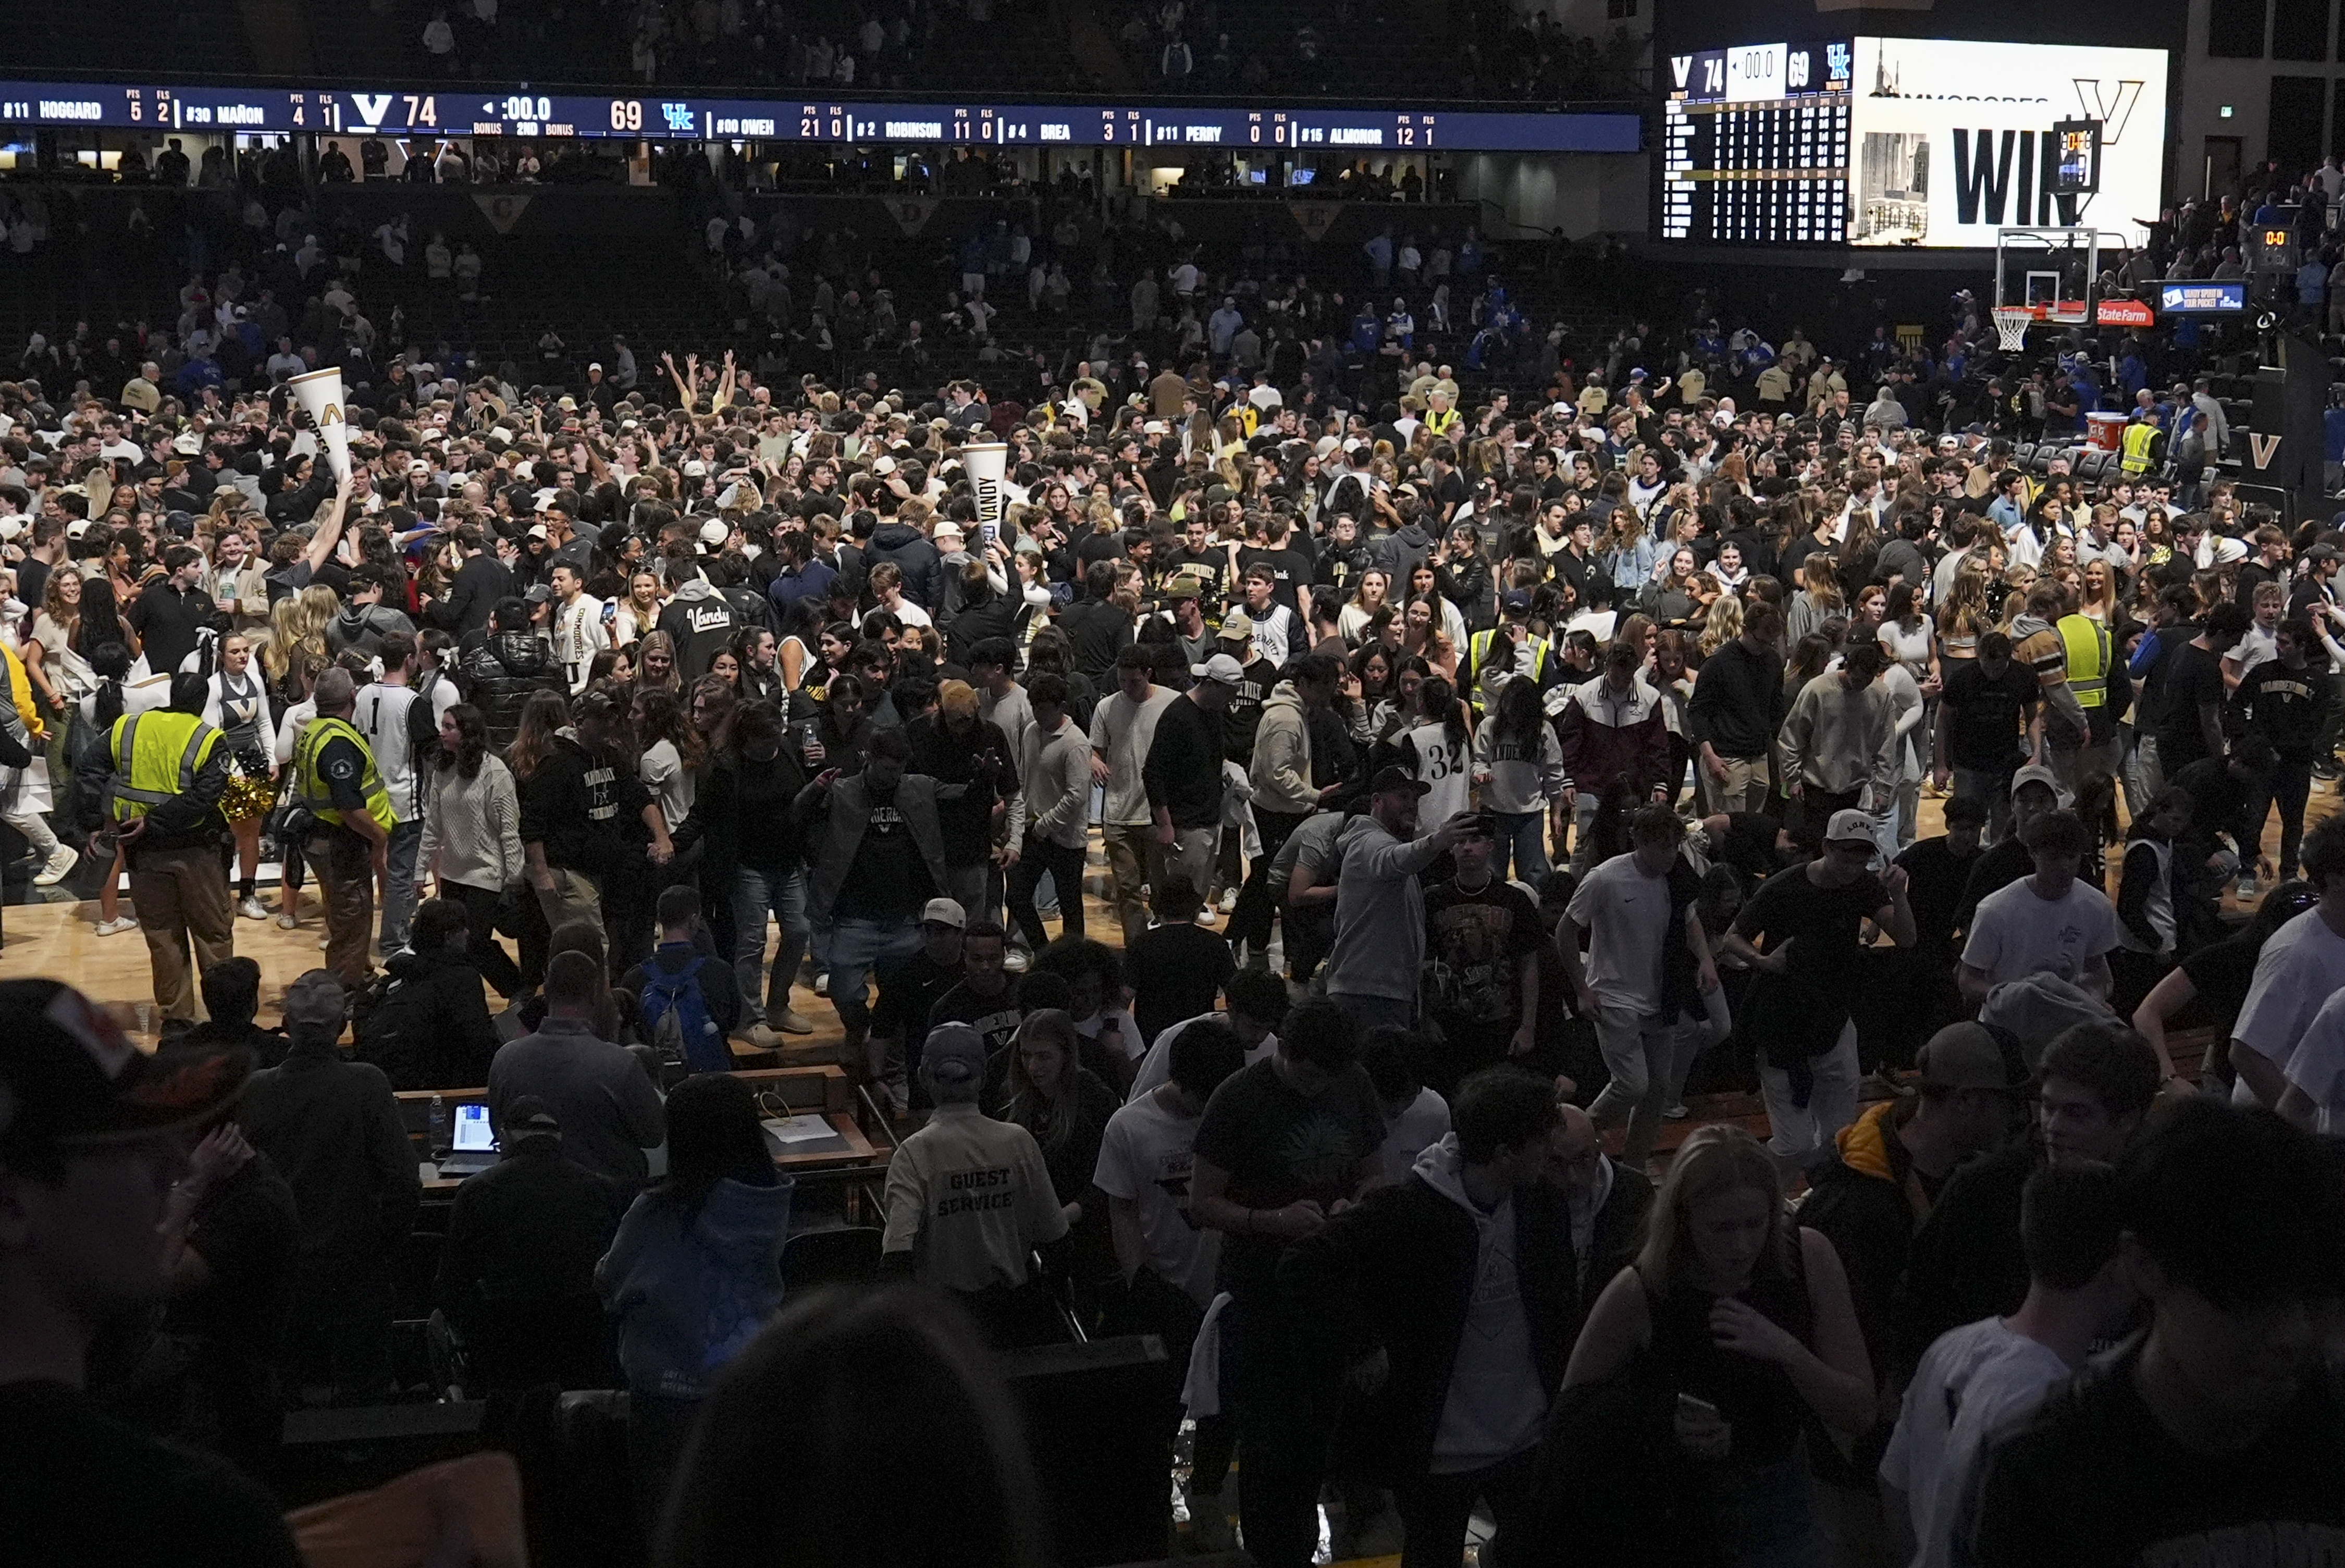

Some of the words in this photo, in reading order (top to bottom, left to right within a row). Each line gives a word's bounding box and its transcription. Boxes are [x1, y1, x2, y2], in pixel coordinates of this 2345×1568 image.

[1704, 58, 1723, 93] 74
[1788, 51, 1809, 87] 69
[126, 89, 140, 99] PTS
[156, 90, 170, 100] FLS
[290, 94, 303, 103] PTS
[319, 94, 332, 104] FLS
[3, 102, 29, 118] #11
[40, 101, 102, 120] HOGGARD
[131, 101, 141, 121] 5
[158, 102, 168, 121] 2
[186, 106, 211, 122] #30
[217, 104, 264, 124] MAÑON
[293, 106, 304, 126] 4
[323, 107, 330, 126] 1
[351, 94, 393, 126] V
[403, 95, 437, 127] 74
[611, 101, 641, 130] 69
[804, 106, 816, 115] PTS
[830, 106, 842, 115] FLS
[955, 109, 967, 117] PTS
[981, 109, 993, 118] FLS
[1102, 111, 1114, 119] PTS
[1128, 111, 1140, 120] FLS
[1249, 113, 1261, 121] PTS
[1274, 114, 1286, 122] FLS
[1398, 115, 1410, 124] PTS
[1423, 116, 1435, 125] FLS
[473, 122, 502, 134] BONUS
[516, 122, 538, 136] 2ND
[546, 124, 574, 136] BONUS
[717, 119, 739, 133] #00
[741, 119, 774, 135] OWEH
[801, 118, 819, 137] 21
[832, 119, 841, 137] 0
[885, 121, 942, 138] ROBINSON
[954, 121, 969, 139] 11
[982, 121, 991, 139] 0
[1041, 124, 1070, 140] BREA
[1104, 124, 1113, 141] 3
[1130, 124, 1137, 141] 1
[1156, 126, 1178, 140] #11
[1186, 126, 1222, 142] PERRY
[1251, 126, 1260, 142] 0
[1275, 126, 1285, 143] 0
[1301, 128, 1323, 142] #15
[1329, 128, 1382, 144] ALMONOR
[1397, 128, 1413, 145] 12
[1426, 128, 1432, 145] 1
[2249, 433, 2281, 470] V
[978, 477, 997, 522] VANDY
[687, 606, 731, 633] Vandy
[573, 608, 585, 659] COMMODORES
[226, 697, 257, 723] V
[370, 698, 379, 735] 1
[1429, 739, 1463, 779] 32
[950, 1169, 1010, 1189] GUEST
